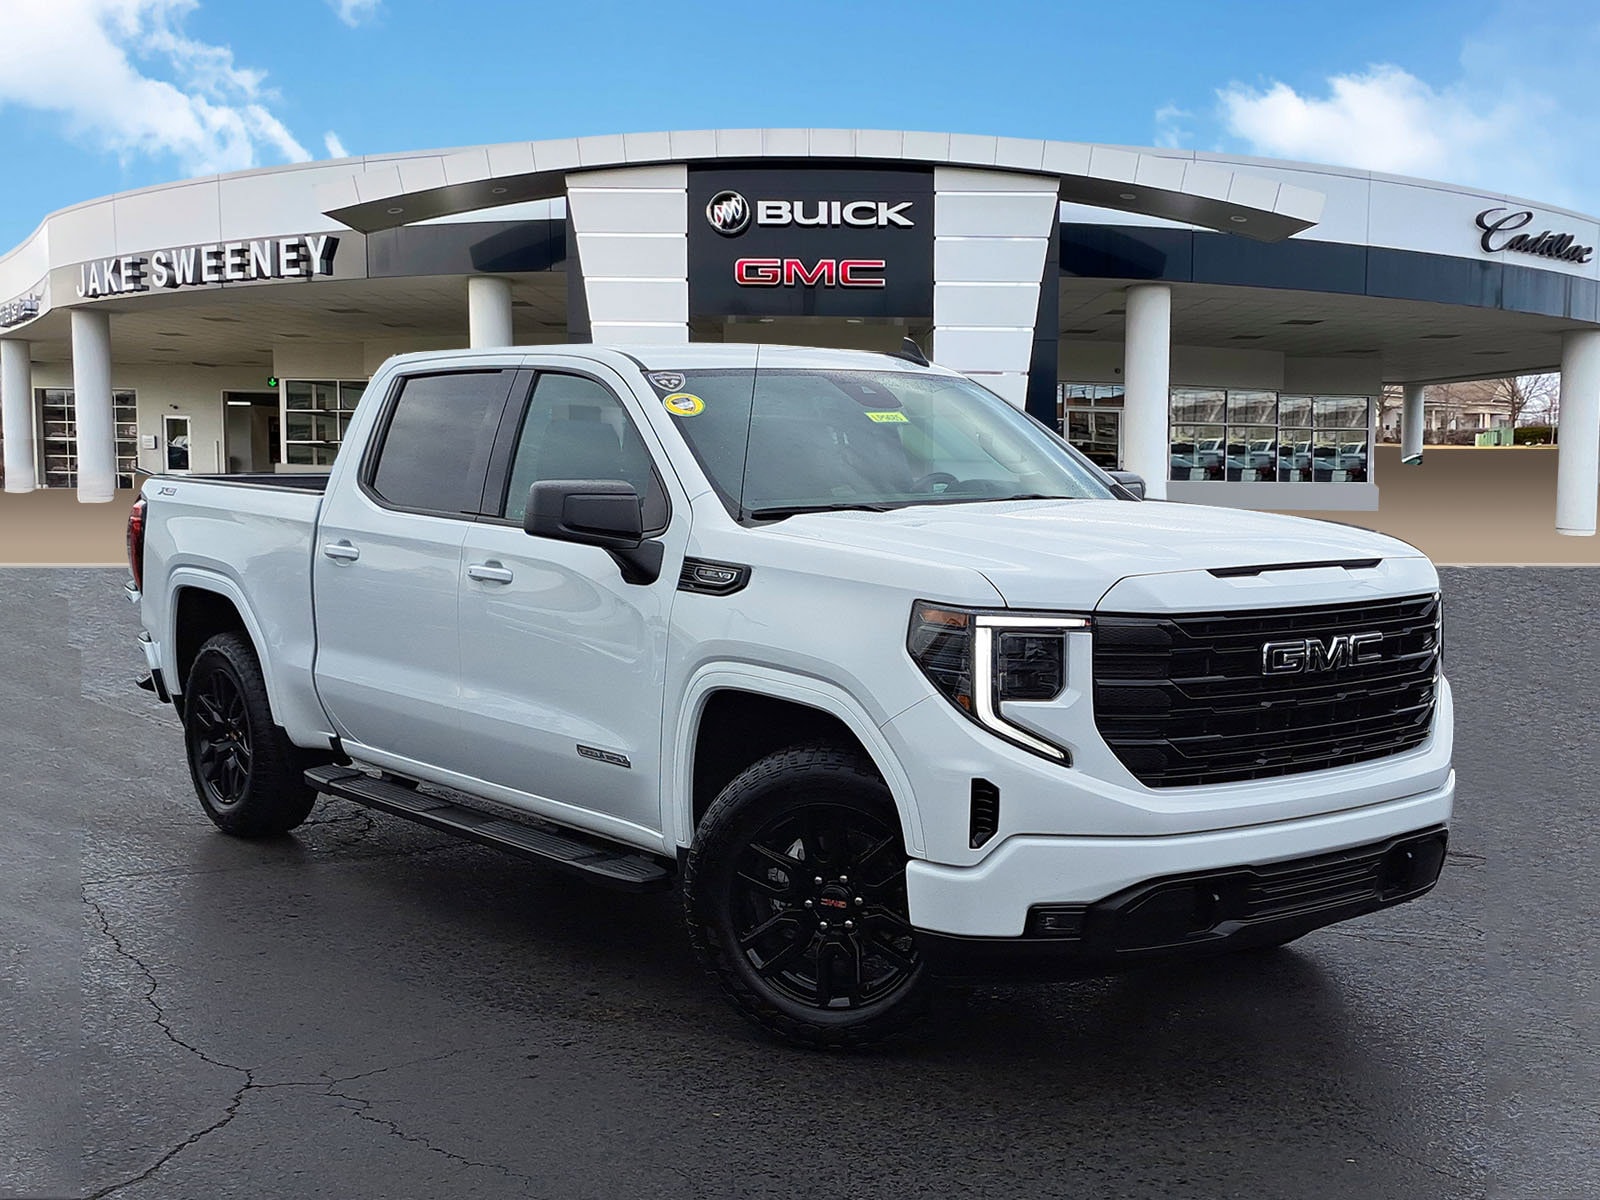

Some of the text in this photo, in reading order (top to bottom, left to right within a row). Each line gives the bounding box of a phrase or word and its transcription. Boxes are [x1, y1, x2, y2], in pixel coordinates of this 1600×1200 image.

[757, 200, 915, 227] BUICK
[1475, 207, 1594, 264] Cadillac
[76, 235, 334, 298] JAKE SWEENEY
[734, 257, 886, 287] GMC
[1262, 631, 1384, 676] GMC
